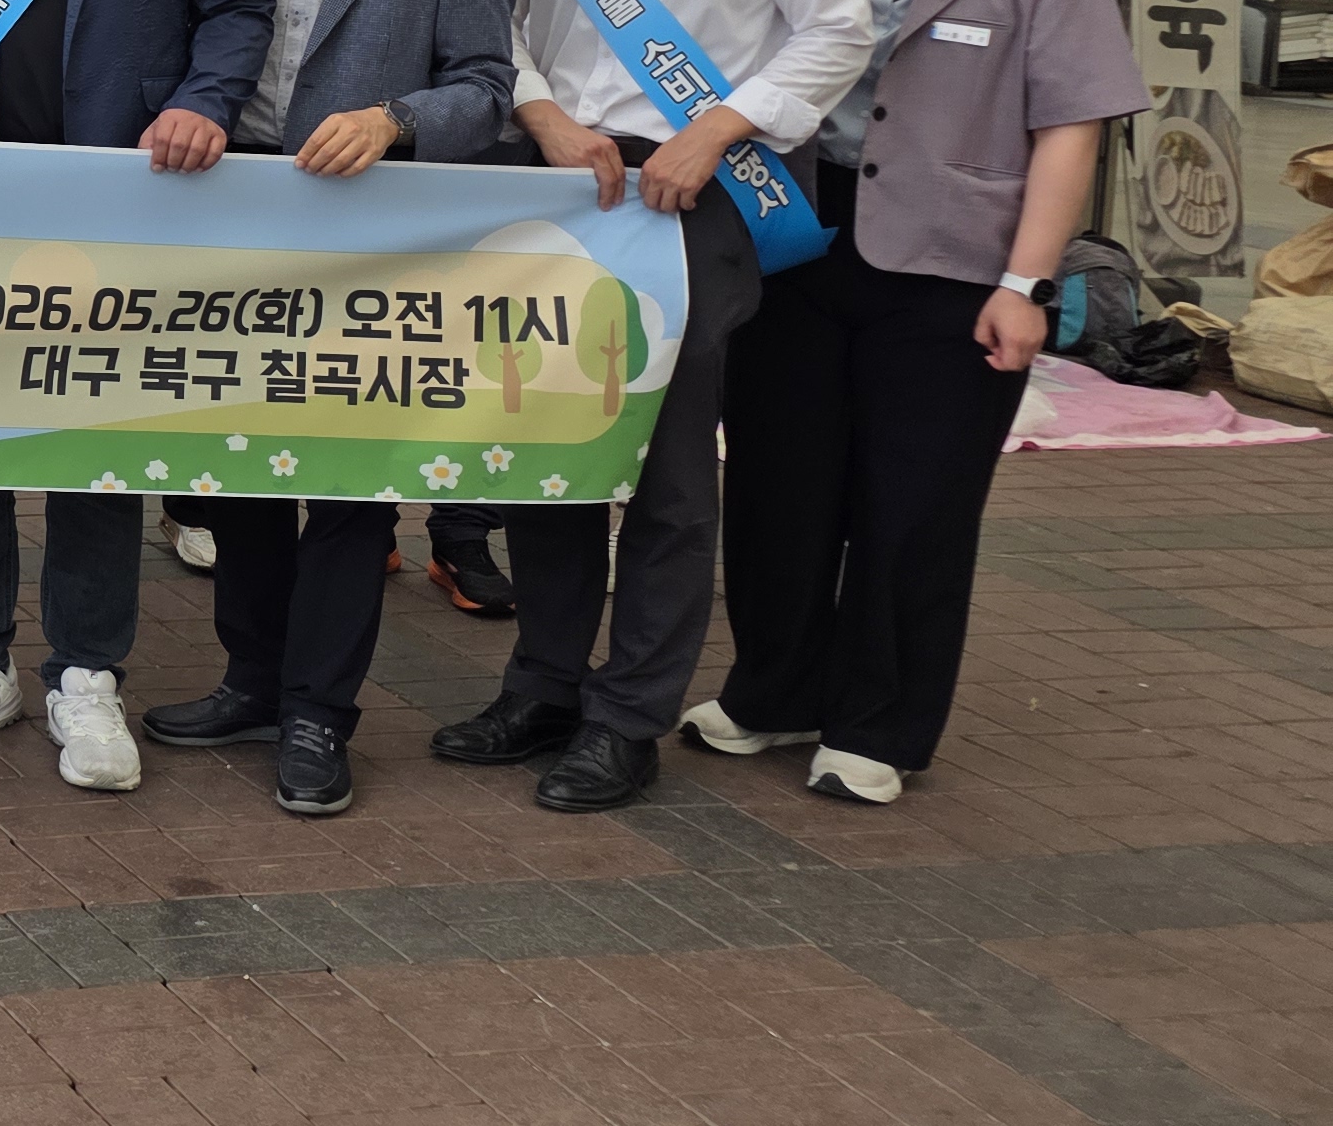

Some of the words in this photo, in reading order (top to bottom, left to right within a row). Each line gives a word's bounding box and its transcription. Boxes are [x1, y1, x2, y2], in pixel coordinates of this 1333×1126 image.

[341, 288, 445, 344] 오전
[463, 295, 570, 346] 11시
[19, 344, 121, 398] 대구
[139, 347, 242, 402] 북구
[260, 348, 470, 410] 칠곡시장
